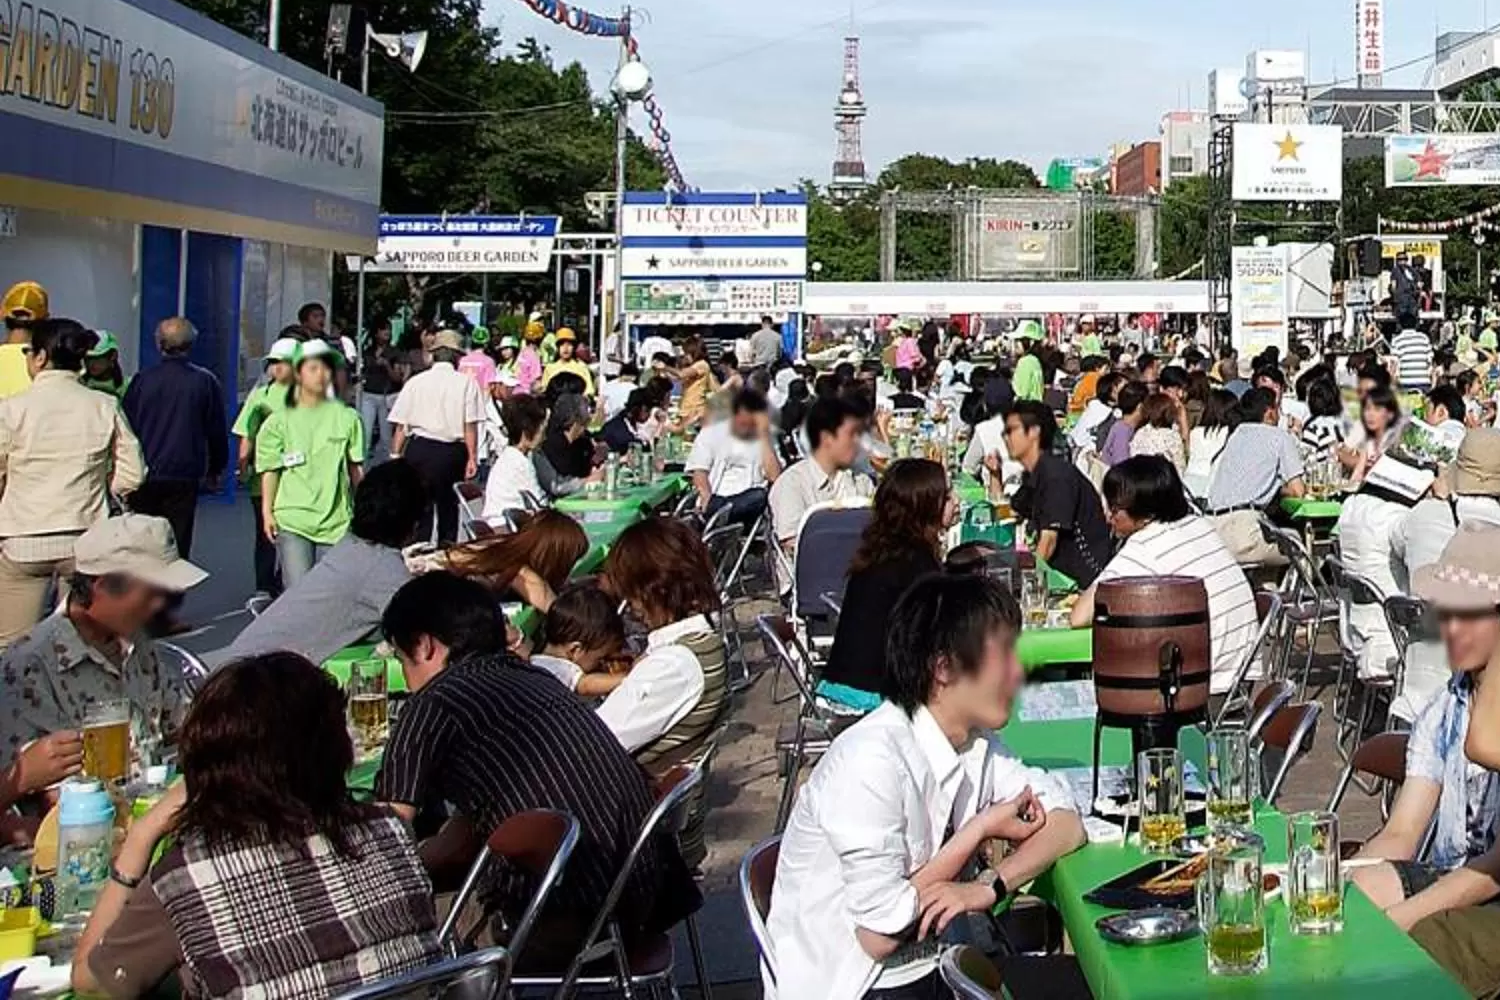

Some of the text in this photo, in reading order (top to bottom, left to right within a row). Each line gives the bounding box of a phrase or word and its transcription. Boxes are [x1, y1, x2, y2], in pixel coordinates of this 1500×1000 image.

[129, 47, 174, 139] 130
[635, 207, 798, 224] TICKET COUNTER
[986, 220, 1022, 231] KIRIN
[385, 251, 445, 263] SAPPORO
[484, 251, 539, 263] GARDEN
